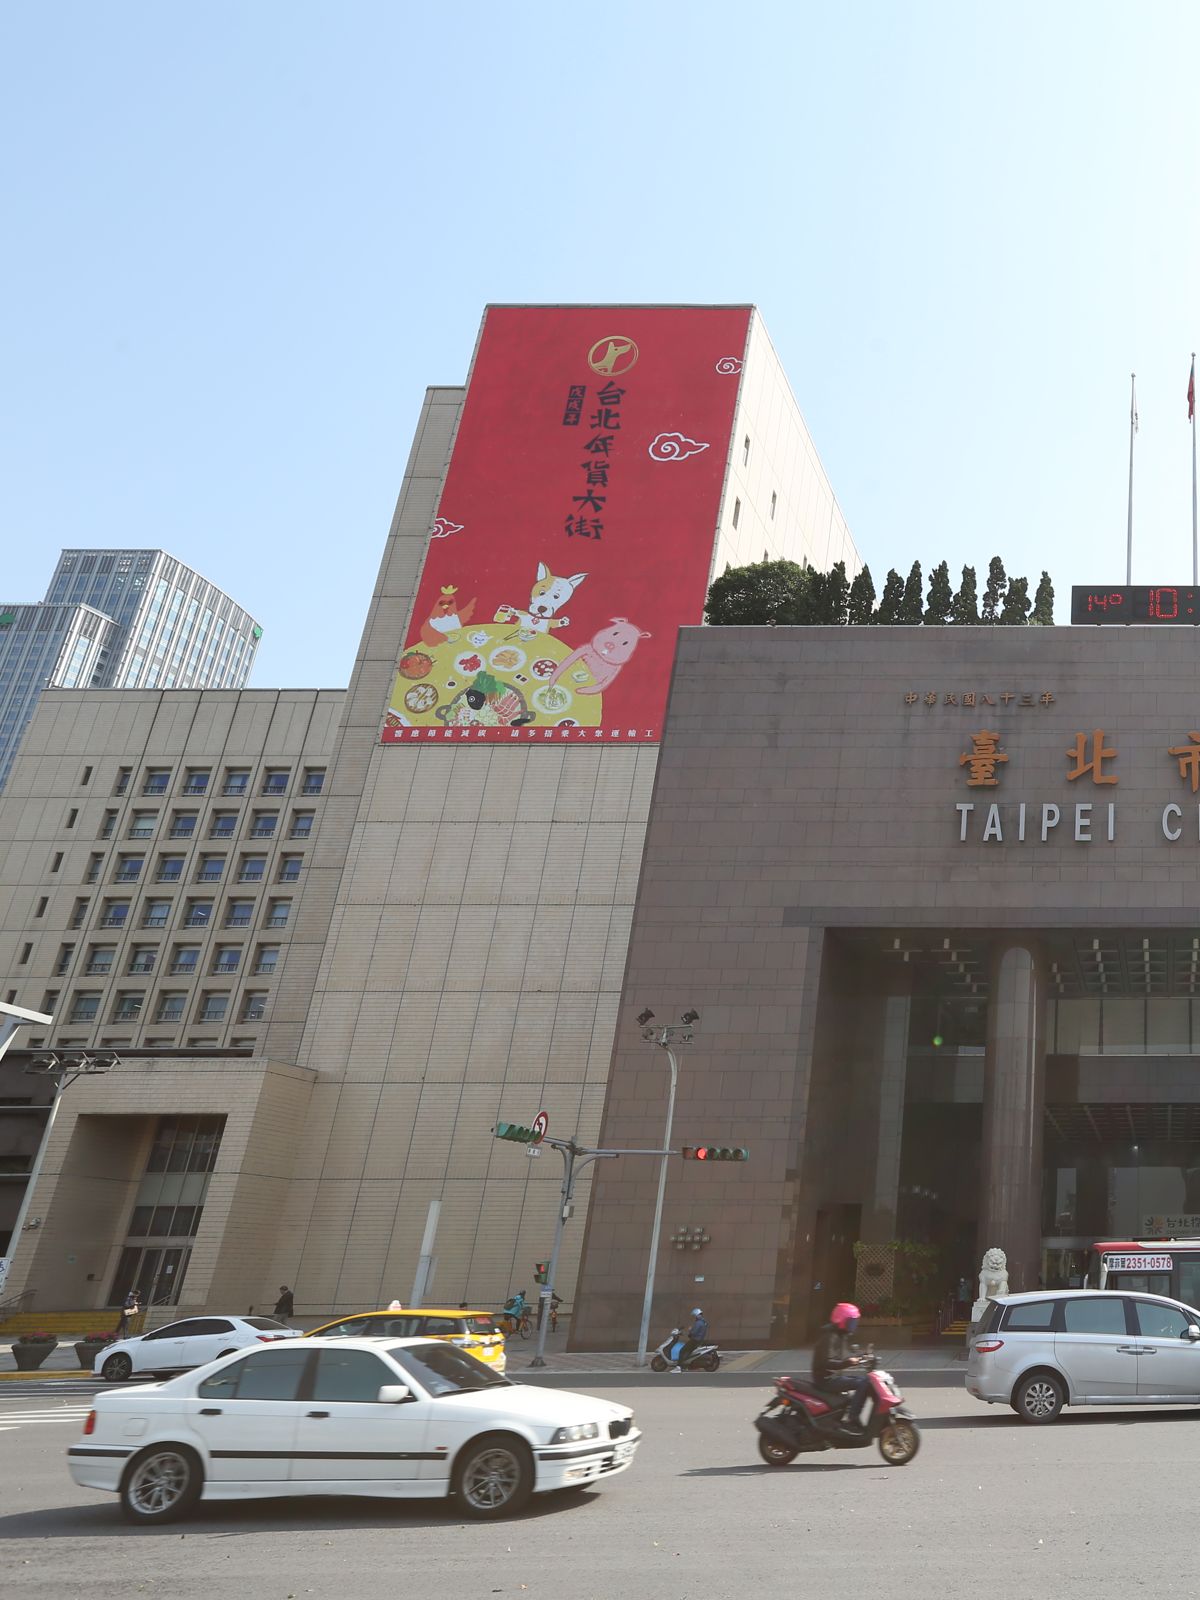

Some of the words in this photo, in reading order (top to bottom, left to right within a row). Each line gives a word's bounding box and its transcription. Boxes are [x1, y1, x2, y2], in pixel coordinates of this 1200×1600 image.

[565, 380, 627, 540] 台北年貨大街
[904, 691, 1055, 707] 中華民國八十三年
[956, 803, 1116, 842] TAIPEI
[1126, 1257, 1172, 1269] 2351-0578
